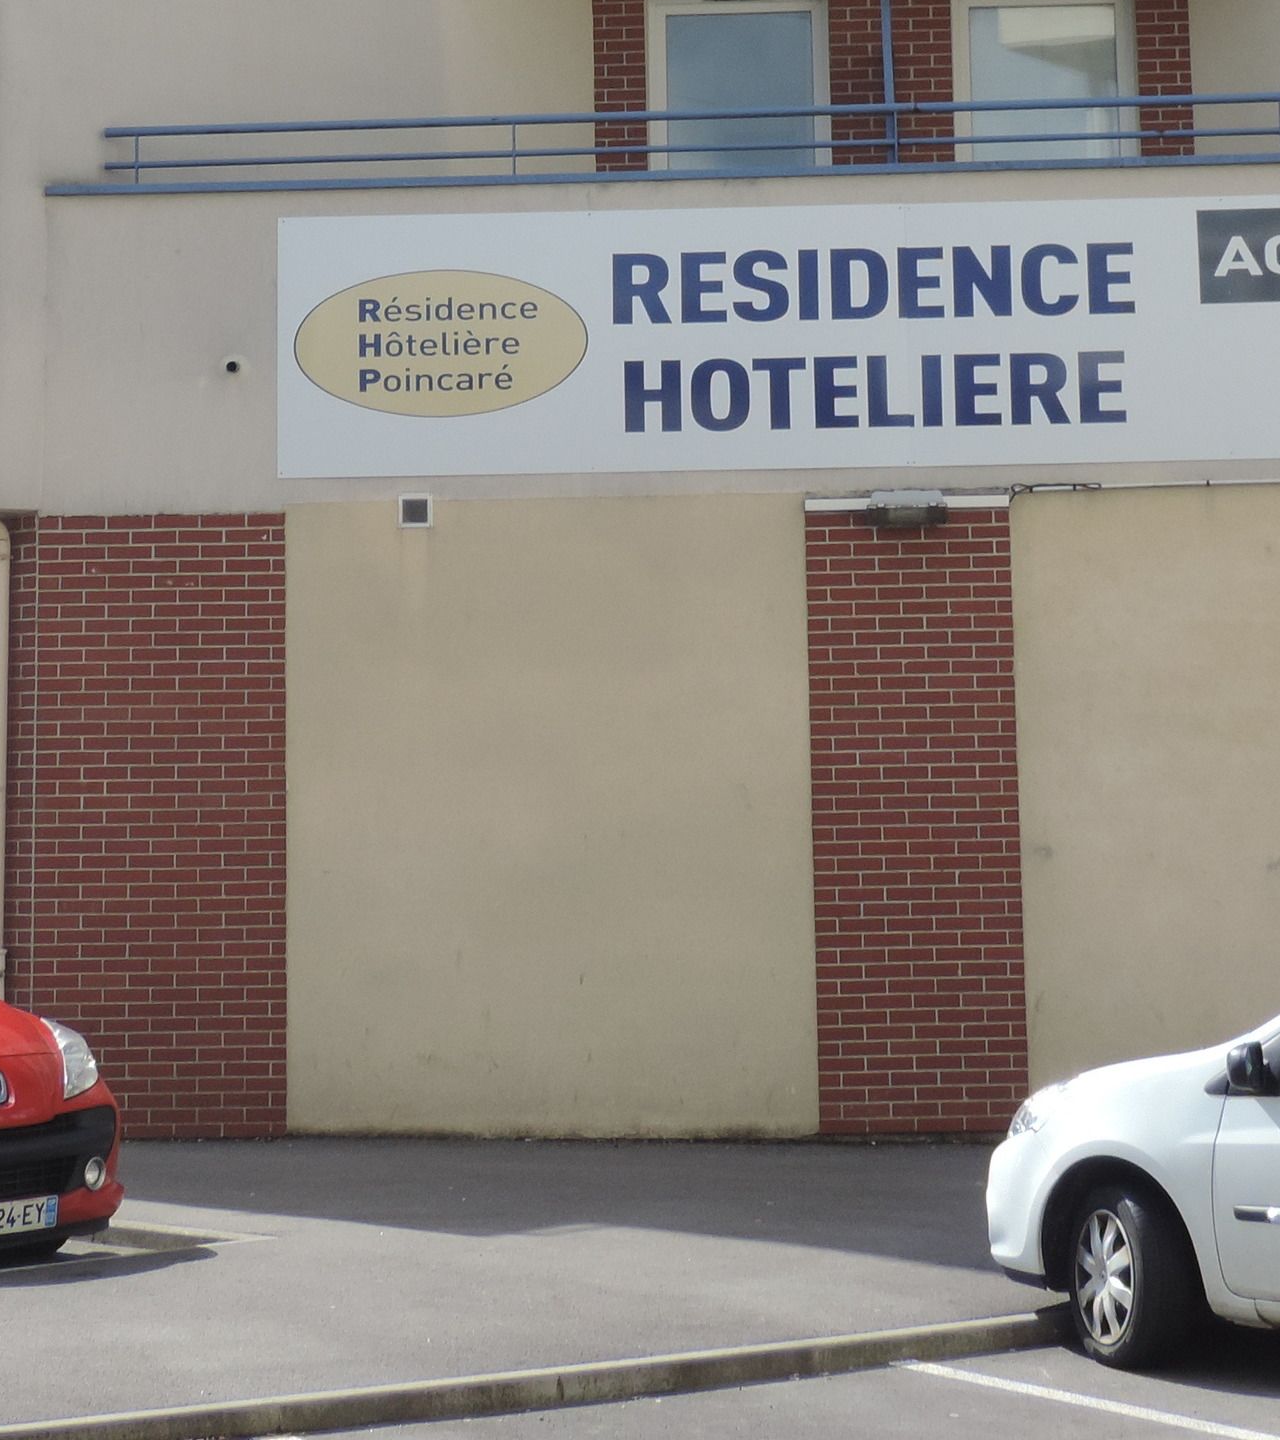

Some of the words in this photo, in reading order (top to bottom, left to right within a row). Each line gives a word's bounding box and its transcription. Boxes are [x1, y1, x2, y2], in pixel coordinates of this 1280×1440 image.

[611, 242, 1136, 325] RESIDENCE
[358, 296, 539, 323] Résidence
[358, 331, 521, 358] Hôtelière
[358, 364, 513, 393] Poincaré
[623, 350, 1127, 433] HOTELIERE
